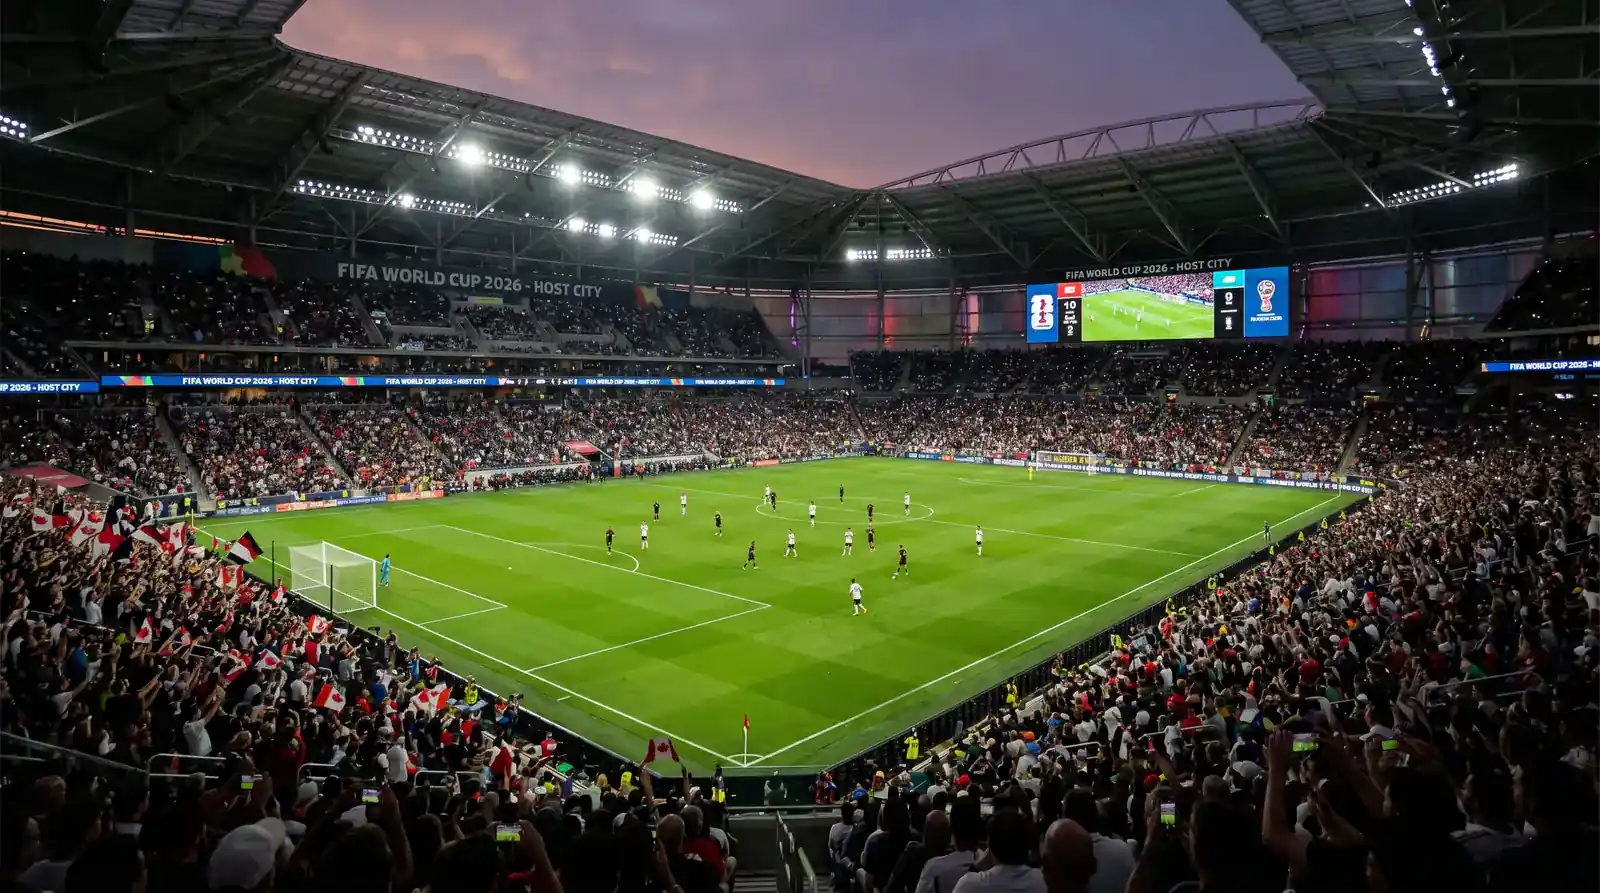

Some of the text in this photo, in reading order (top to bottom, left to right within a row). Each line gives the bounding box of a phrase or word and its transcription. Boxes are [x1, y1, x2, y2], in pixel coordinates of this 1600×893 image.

[1066, 271, 1084, 280] FIFA
[1086, 268, 1119, 278] WORLD
[1122, 266, 1141, 276] CUP
[1143, 264, 1167, 274] 2026
[1176, 261, 1204, 271] HOST
[1207, 258, 1232, 268] CITY
[338, 262, 378, 280] FIFA
[383, 267, 445, 286] WORLD
[450, 272, 480, 288] CUP
[484, 275, 522, 292] 2026
[534, 280, 569, 296] HOST
[573, 284, 602, 298] CITY
[1064, 301, 1076, 309] 10
[182, 377, 202, 385] FIFA
[203, 377, 233, 385] WORLD
[235, 377, 251, 385] CUP
[253, 377, 273, 385] 2026
[279, 377, 300, 385] HOST
[300, 377, 318, 385] CITY
